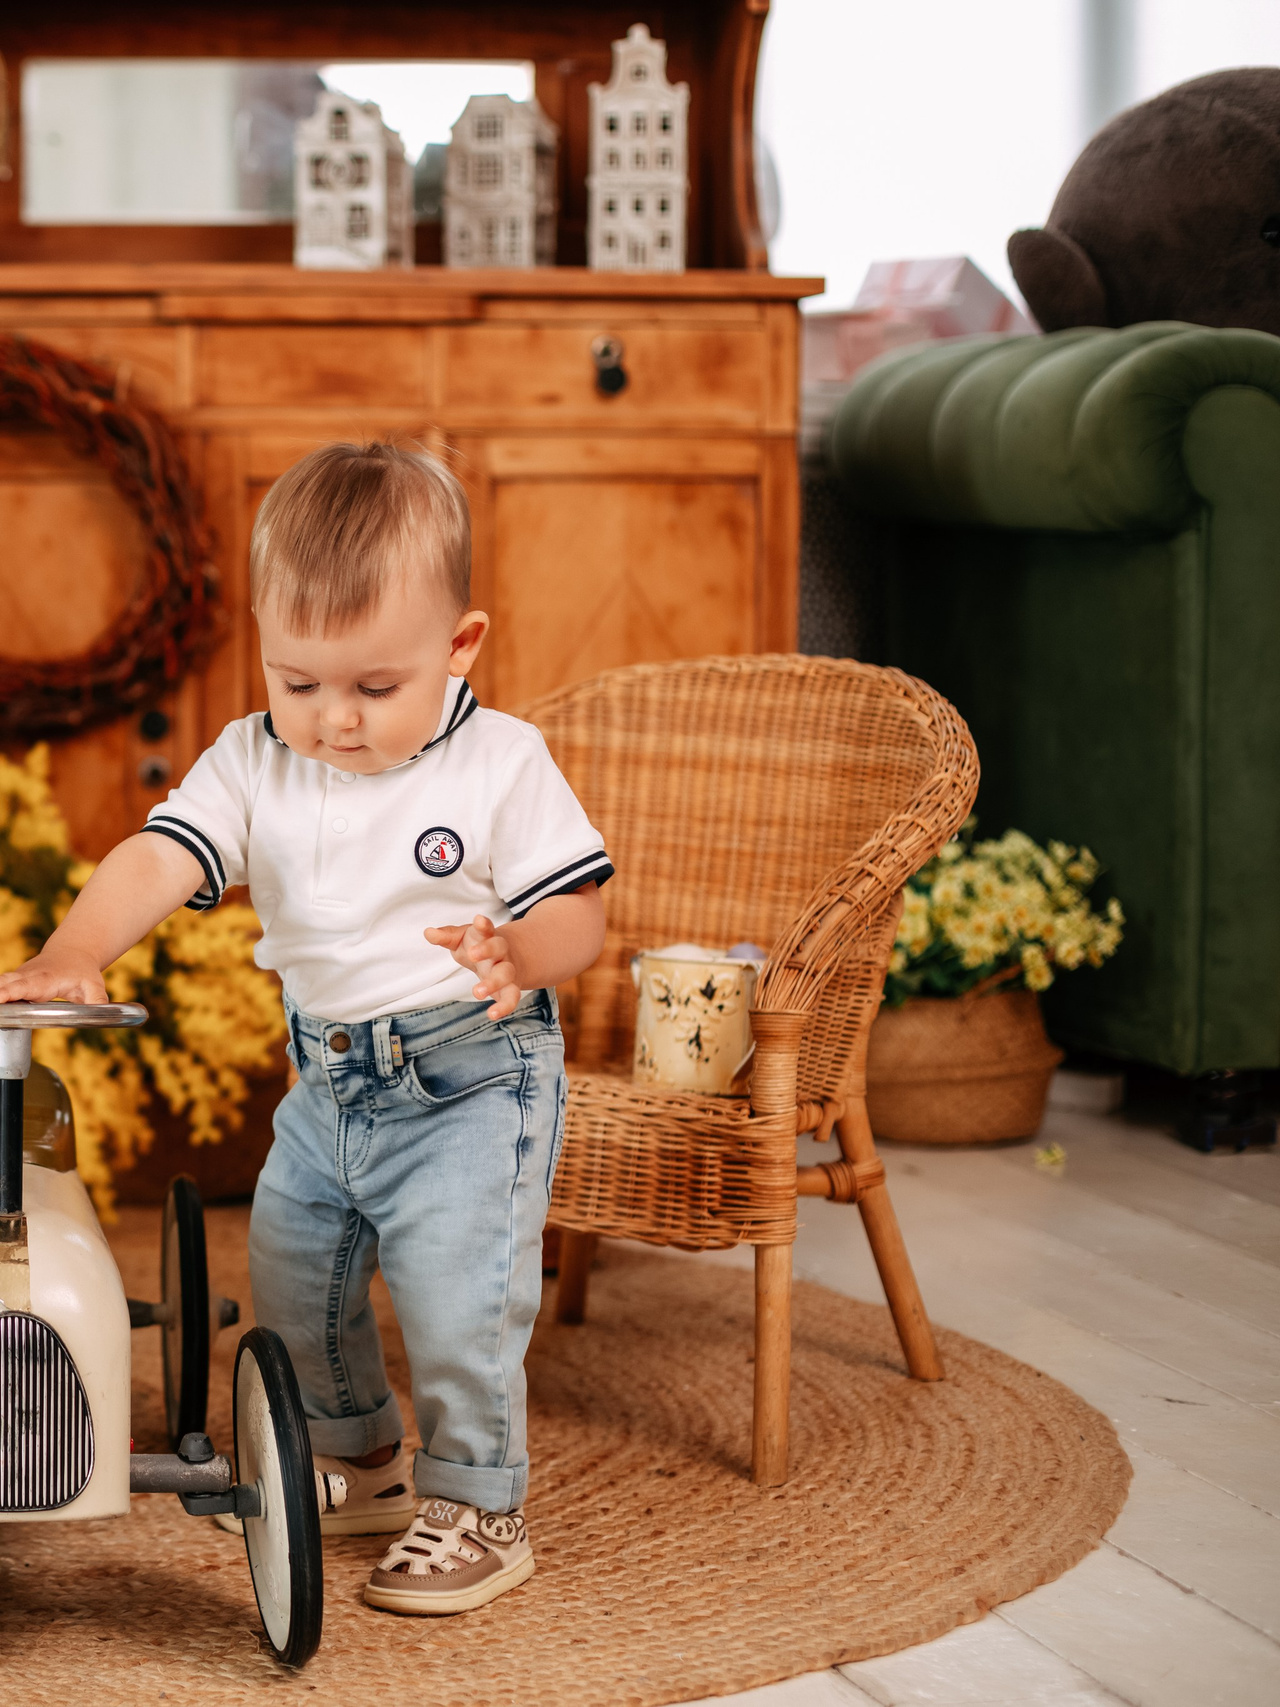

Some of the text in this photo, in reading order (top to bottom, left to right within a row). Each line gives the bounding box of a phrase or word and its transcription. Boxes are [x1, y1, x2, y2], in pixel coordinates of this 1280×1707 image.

[423, 836, 457, 852] SAIL AWAY
[428, 1500, 458, 1523] SR
